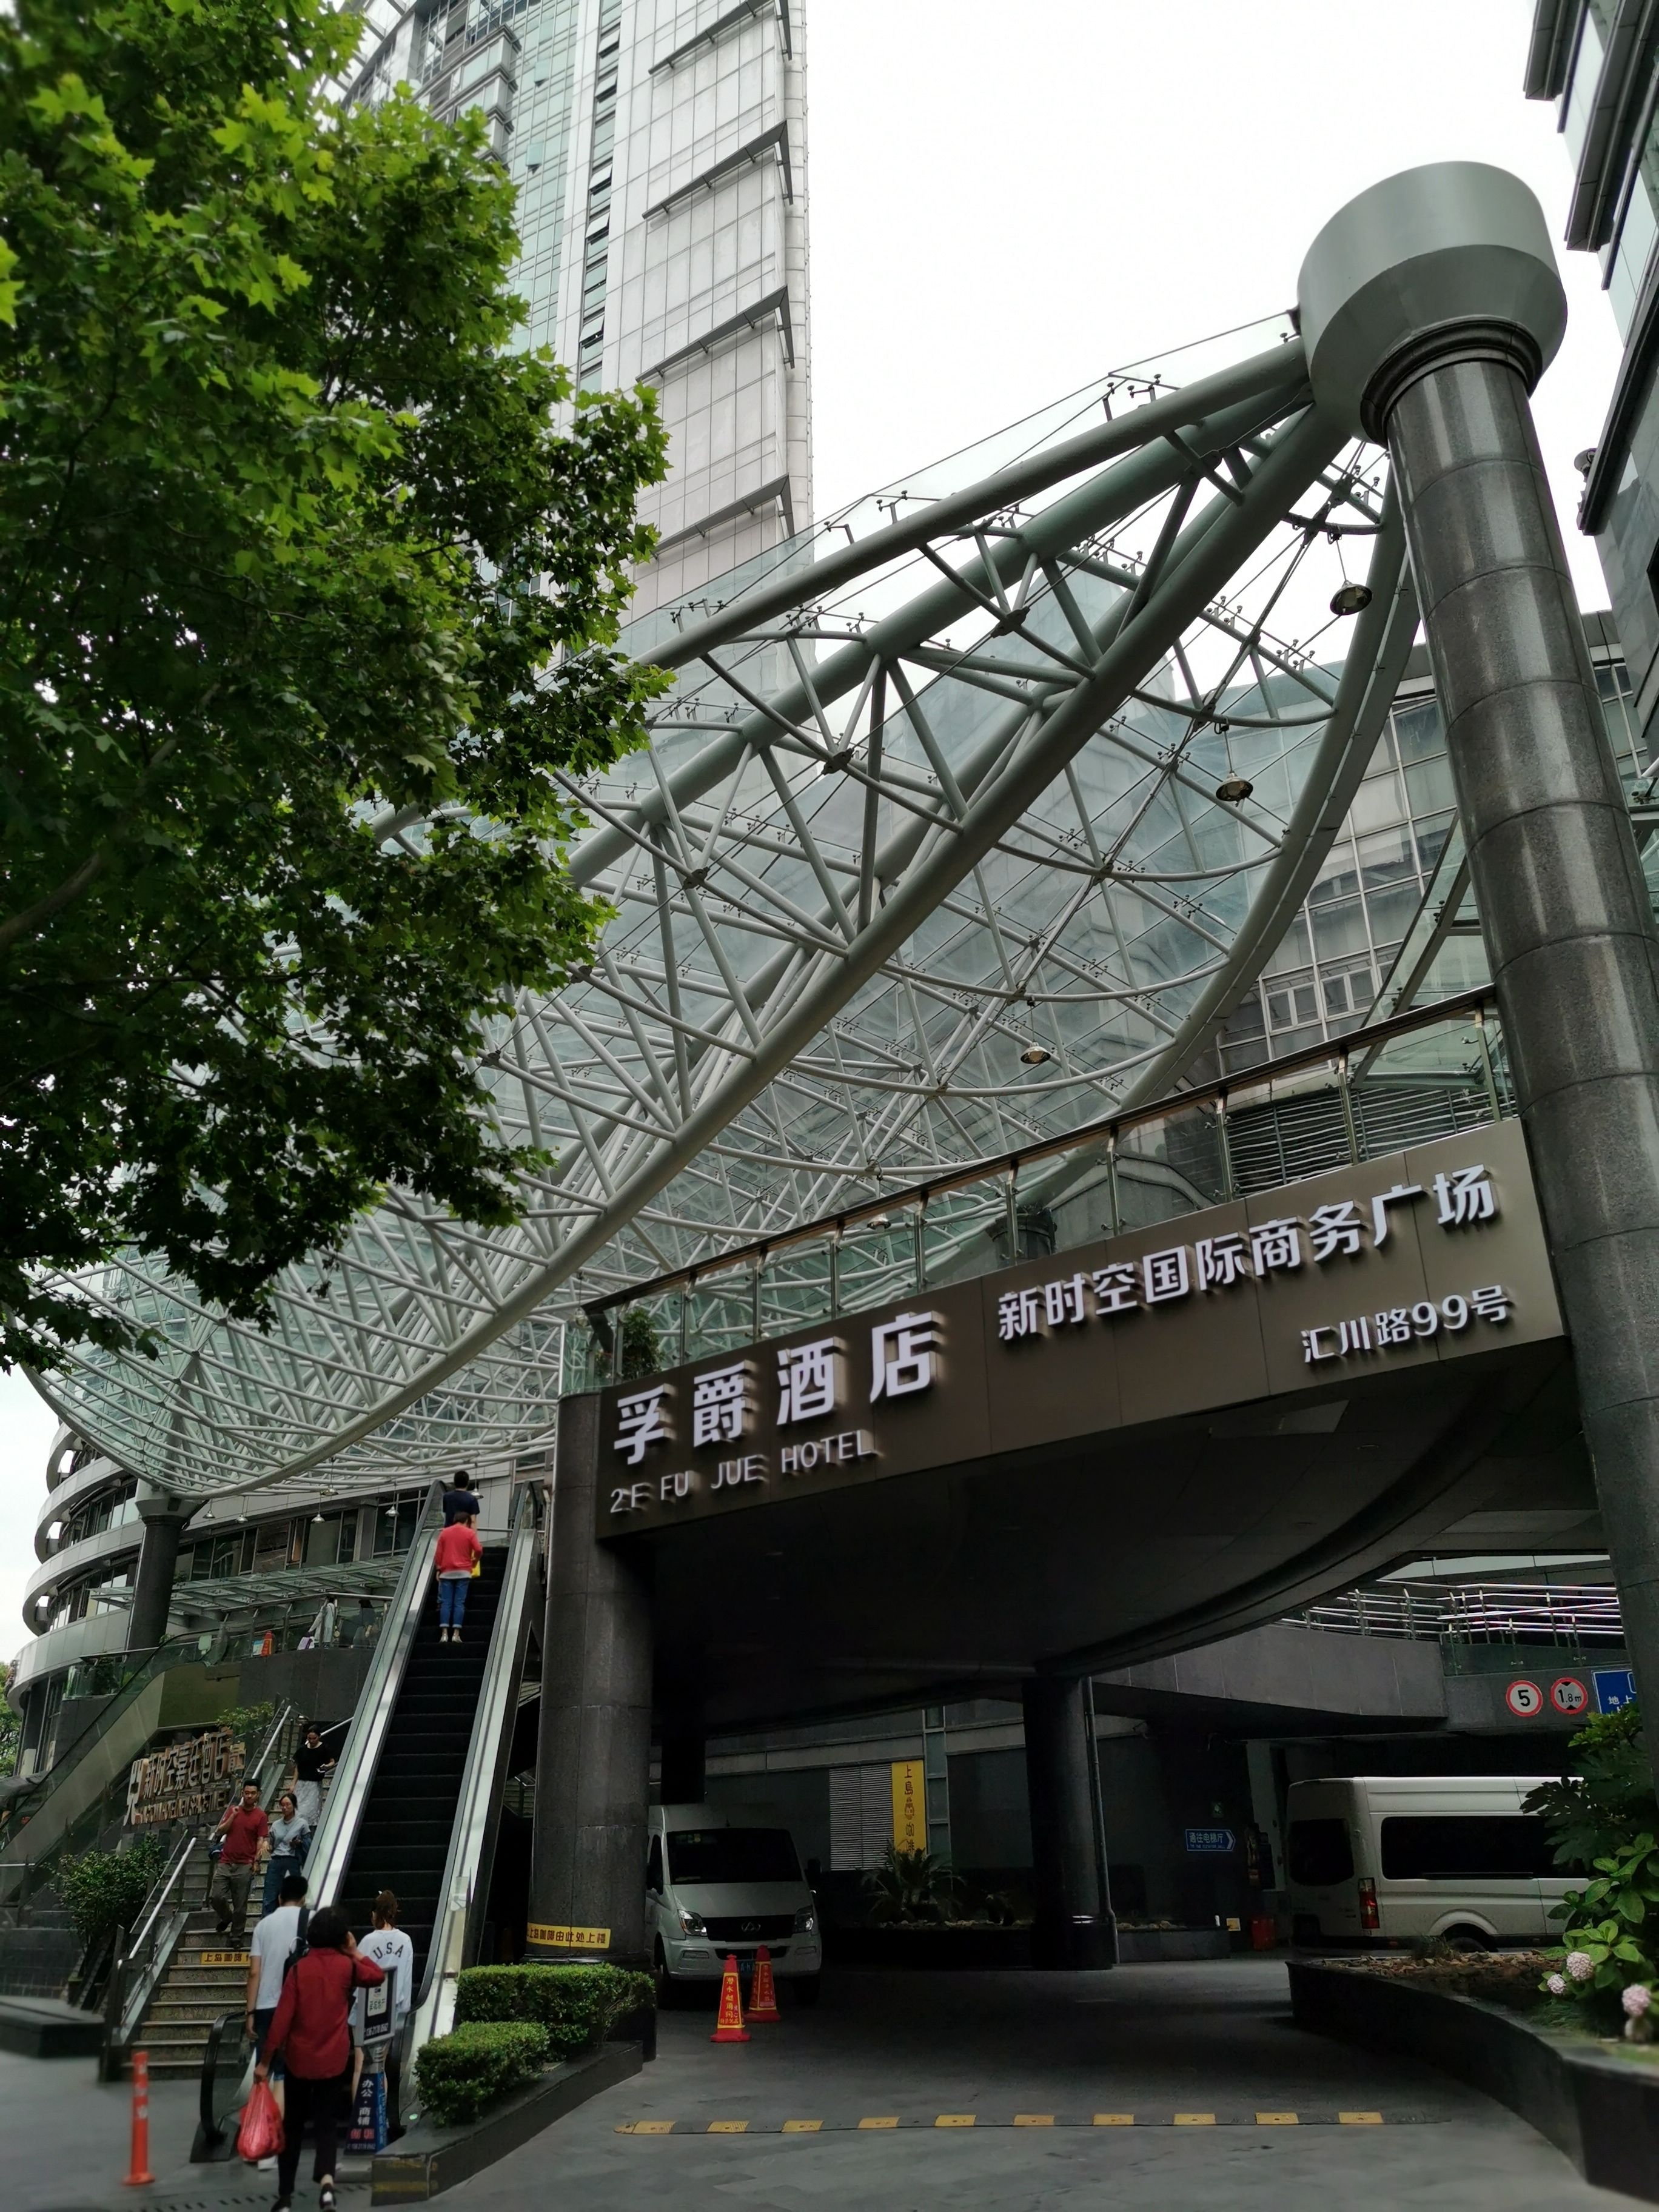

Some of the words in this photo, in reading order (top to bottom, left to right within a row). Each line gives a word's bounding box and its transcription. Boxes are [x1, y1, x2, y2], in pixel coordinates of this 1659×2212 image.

[998, 1163, 1496, 1341] 新时空国际商务广场
[1301, 1284, 1509, 1363] 汇川路99号
[614, 1310, 937, 1466] 孚爵酒店
[610, 1483, 650, 1513] 2F
[660, 1470, 691, 1501] FU
[710, 1455, 765, 1490] JUE
[781, 1429, 874, 1473] HOTEL
[1518, 1689, 1530, 1707] 5
